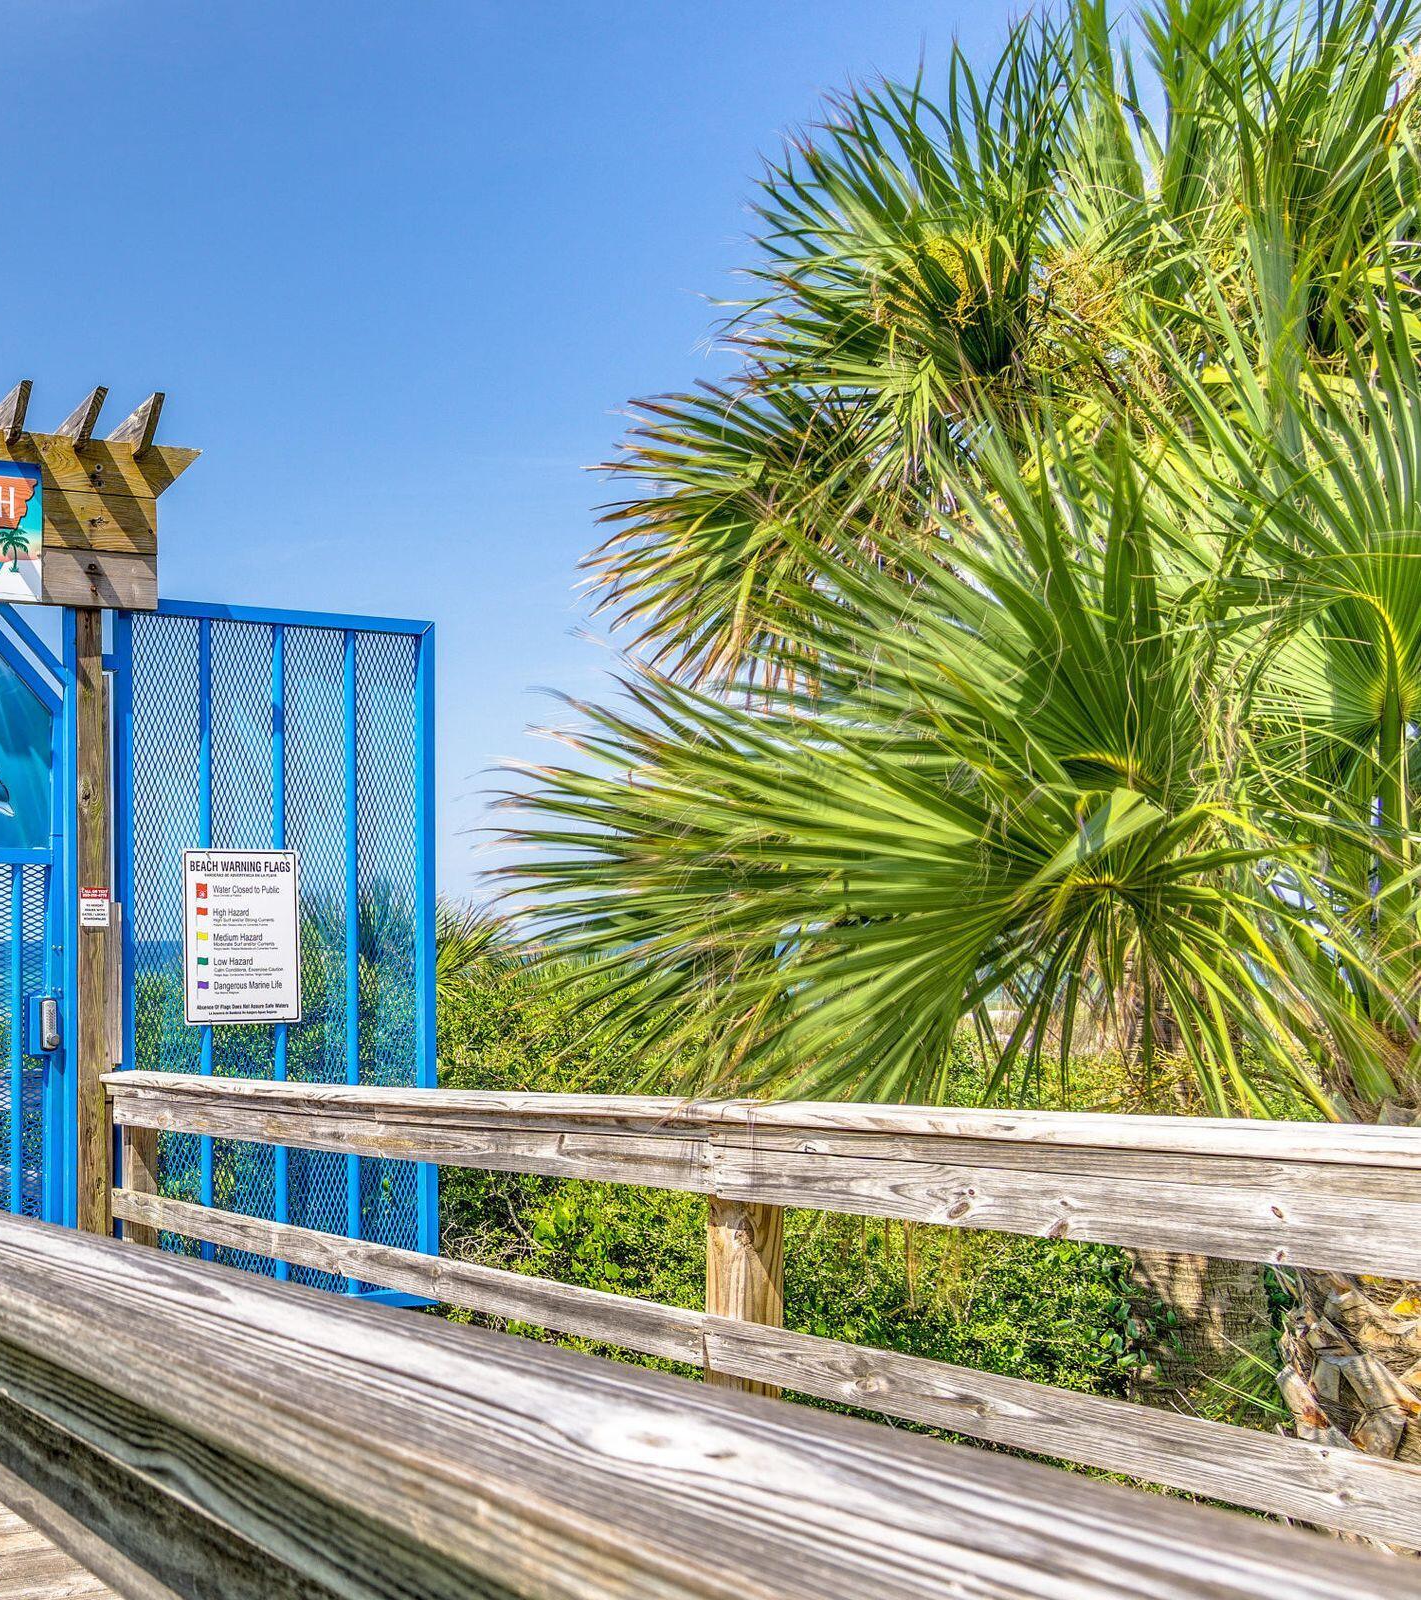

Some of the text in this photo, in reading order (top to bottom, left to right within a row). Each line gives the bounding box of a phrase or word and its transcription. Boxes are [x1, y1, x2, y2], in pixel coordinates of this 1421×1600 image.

[190, 860, 290, 872] BEACH WARNING FLAGS
[213, 885, 230, 893] Water
[232, 885, 253, 894] Closed
[262, 886, 279, 894] Public
[213, 909, 226, 918] High
[214, 982, 247, 991] Dangerous
[271, 981, 282, 989] Life
